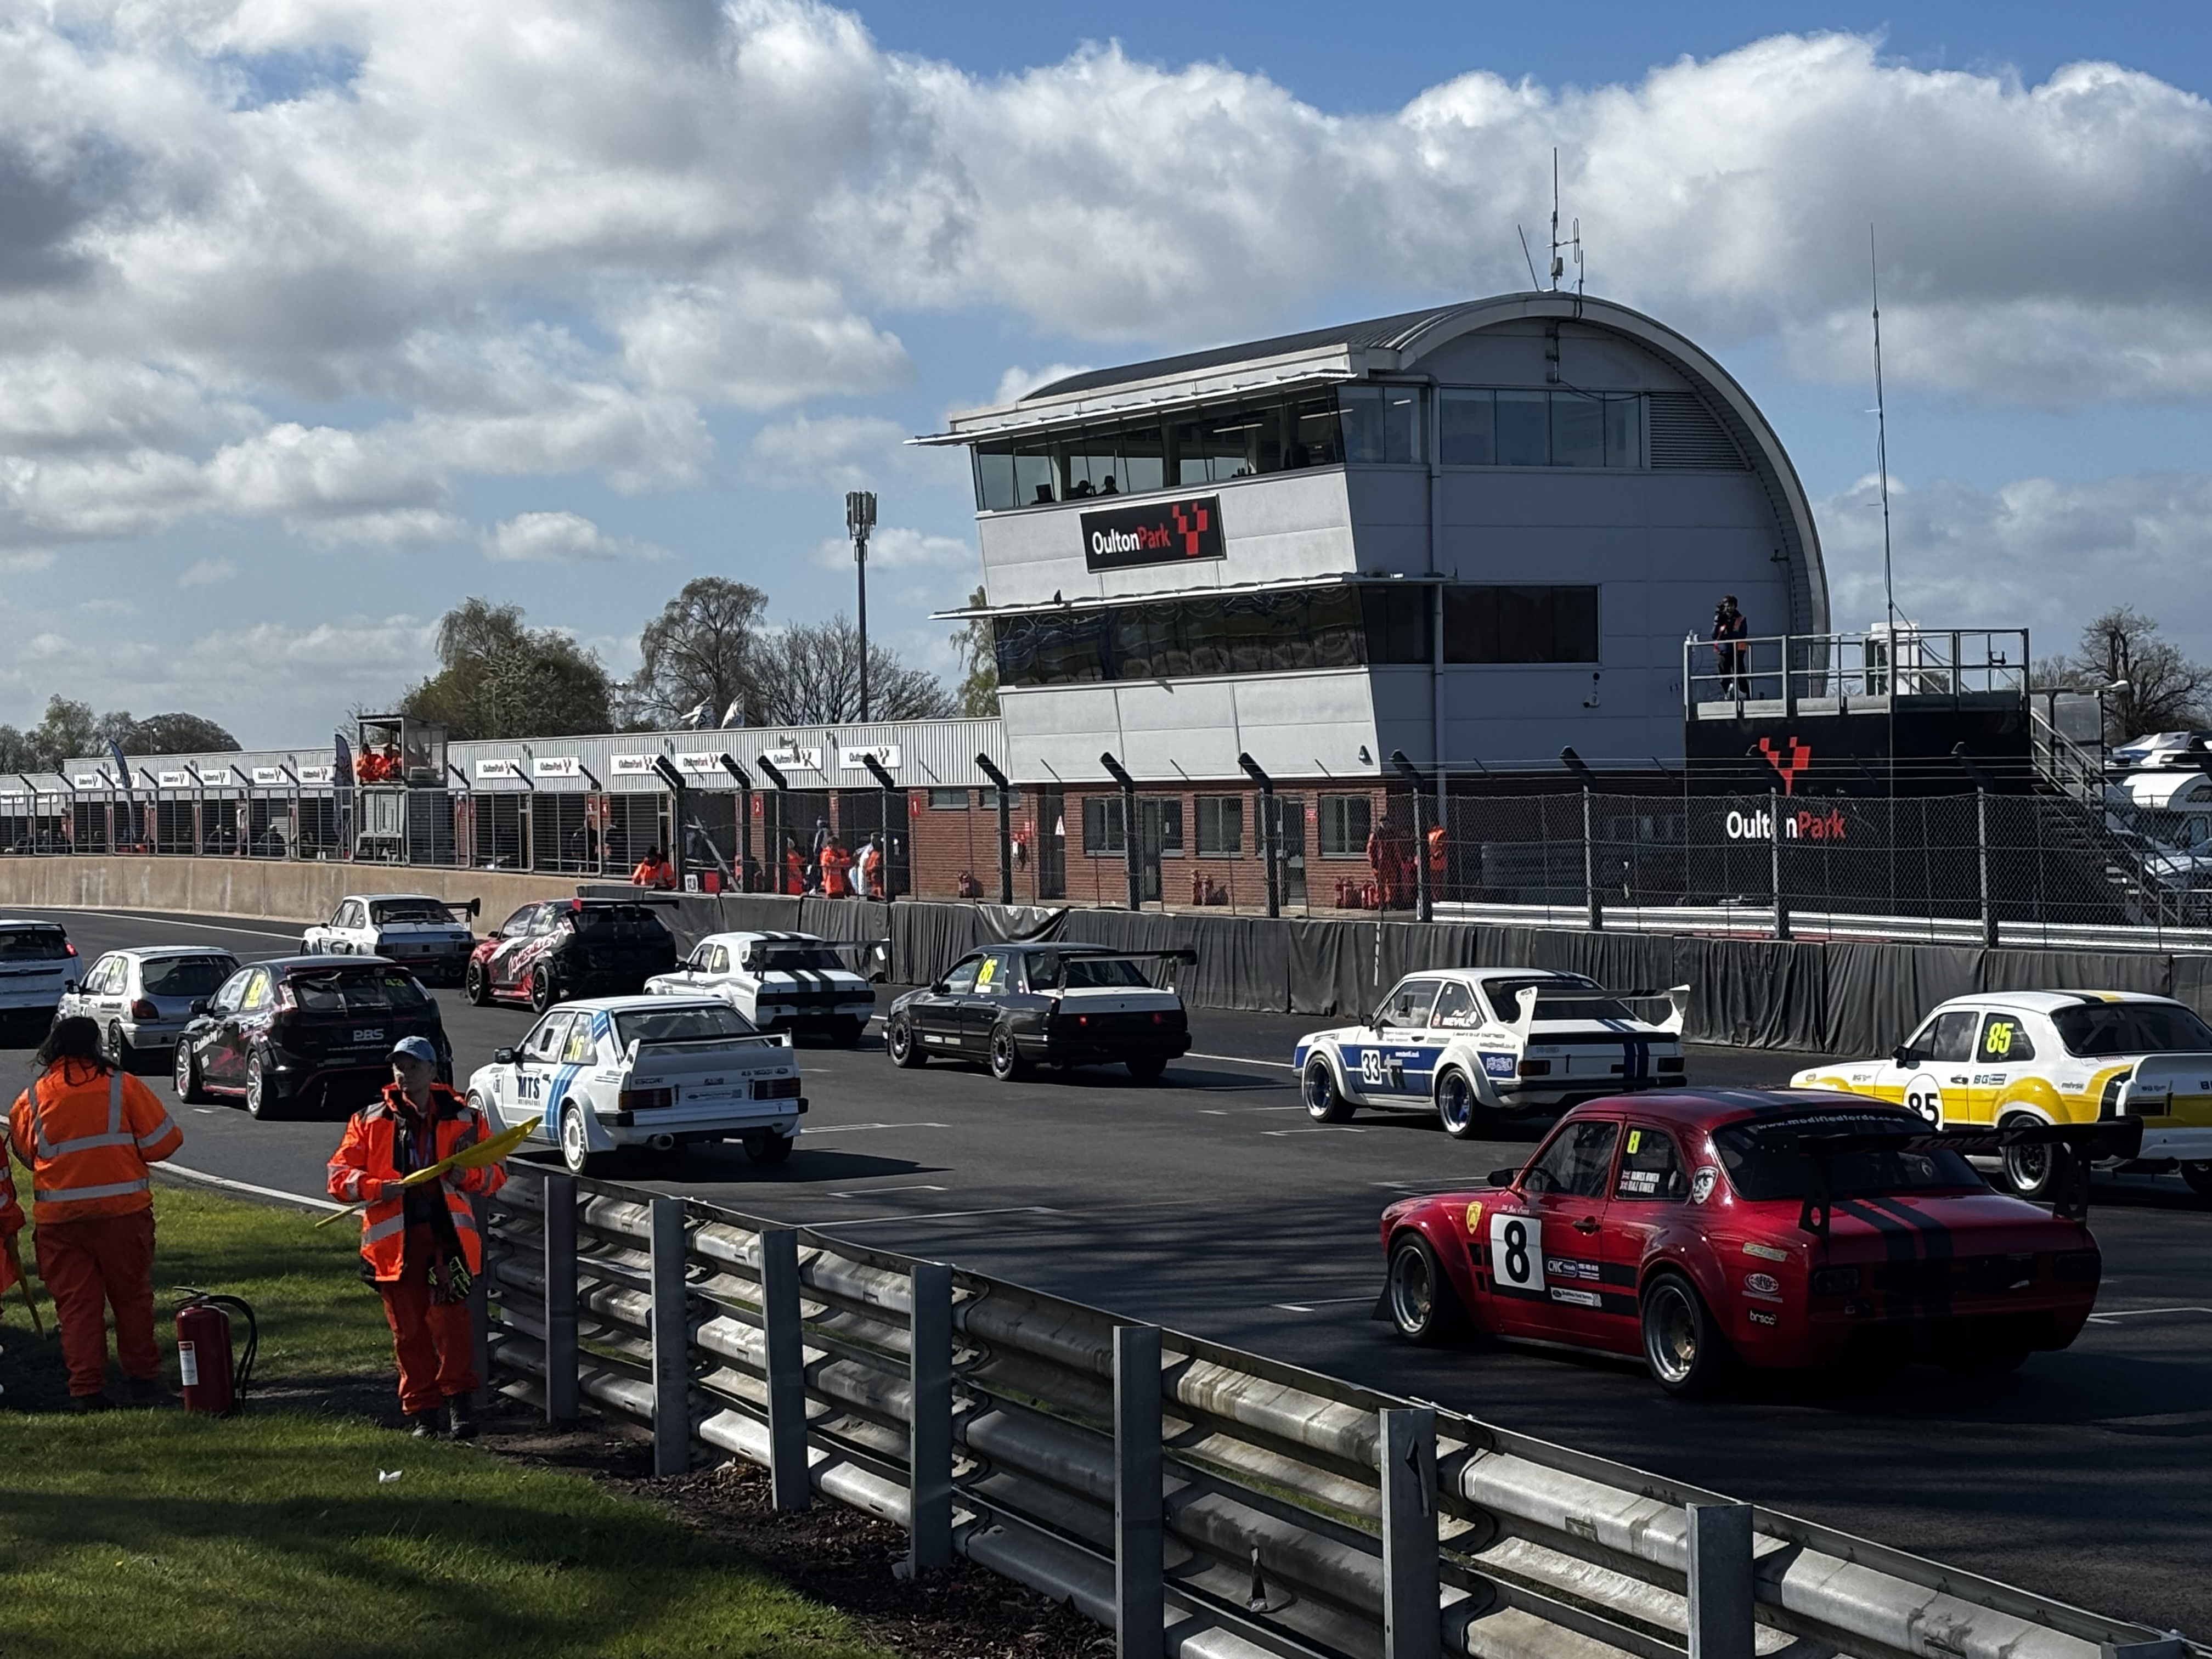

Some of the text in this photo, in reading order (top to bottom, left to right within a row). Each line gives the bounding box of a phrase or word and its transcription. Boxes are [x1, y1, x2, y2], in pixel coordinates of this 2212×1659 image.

[1092, 522, 1171, 555] OultonPark
[1726, 808, 1846, 839] OultnPark
[978, 959, 998, 984] 86
[353, 1028, 384, 1042] PBS
[1986, 1022, 2015, 1054] 85
[568, 1035, 585, 1062] 16
[1363, 1053, 1381, 1081] 33
[517, 1076, 540, 1099] MTS
[1973, 1074, 1989, 1085] BG
[2200, 1081, 2212, 1090] B
[1757, 1114, 1905, 1130] www.modifiedfords.co.uk
[1908, 1092, 1940, 1128] 85
[1627, 1131, 1641, 1154] 8
[1504, 1220, 1531, 1284] 8
[1547, 1260, 1563, 1273] CNC
[1750, 1310, 1775, 1325] brscc
